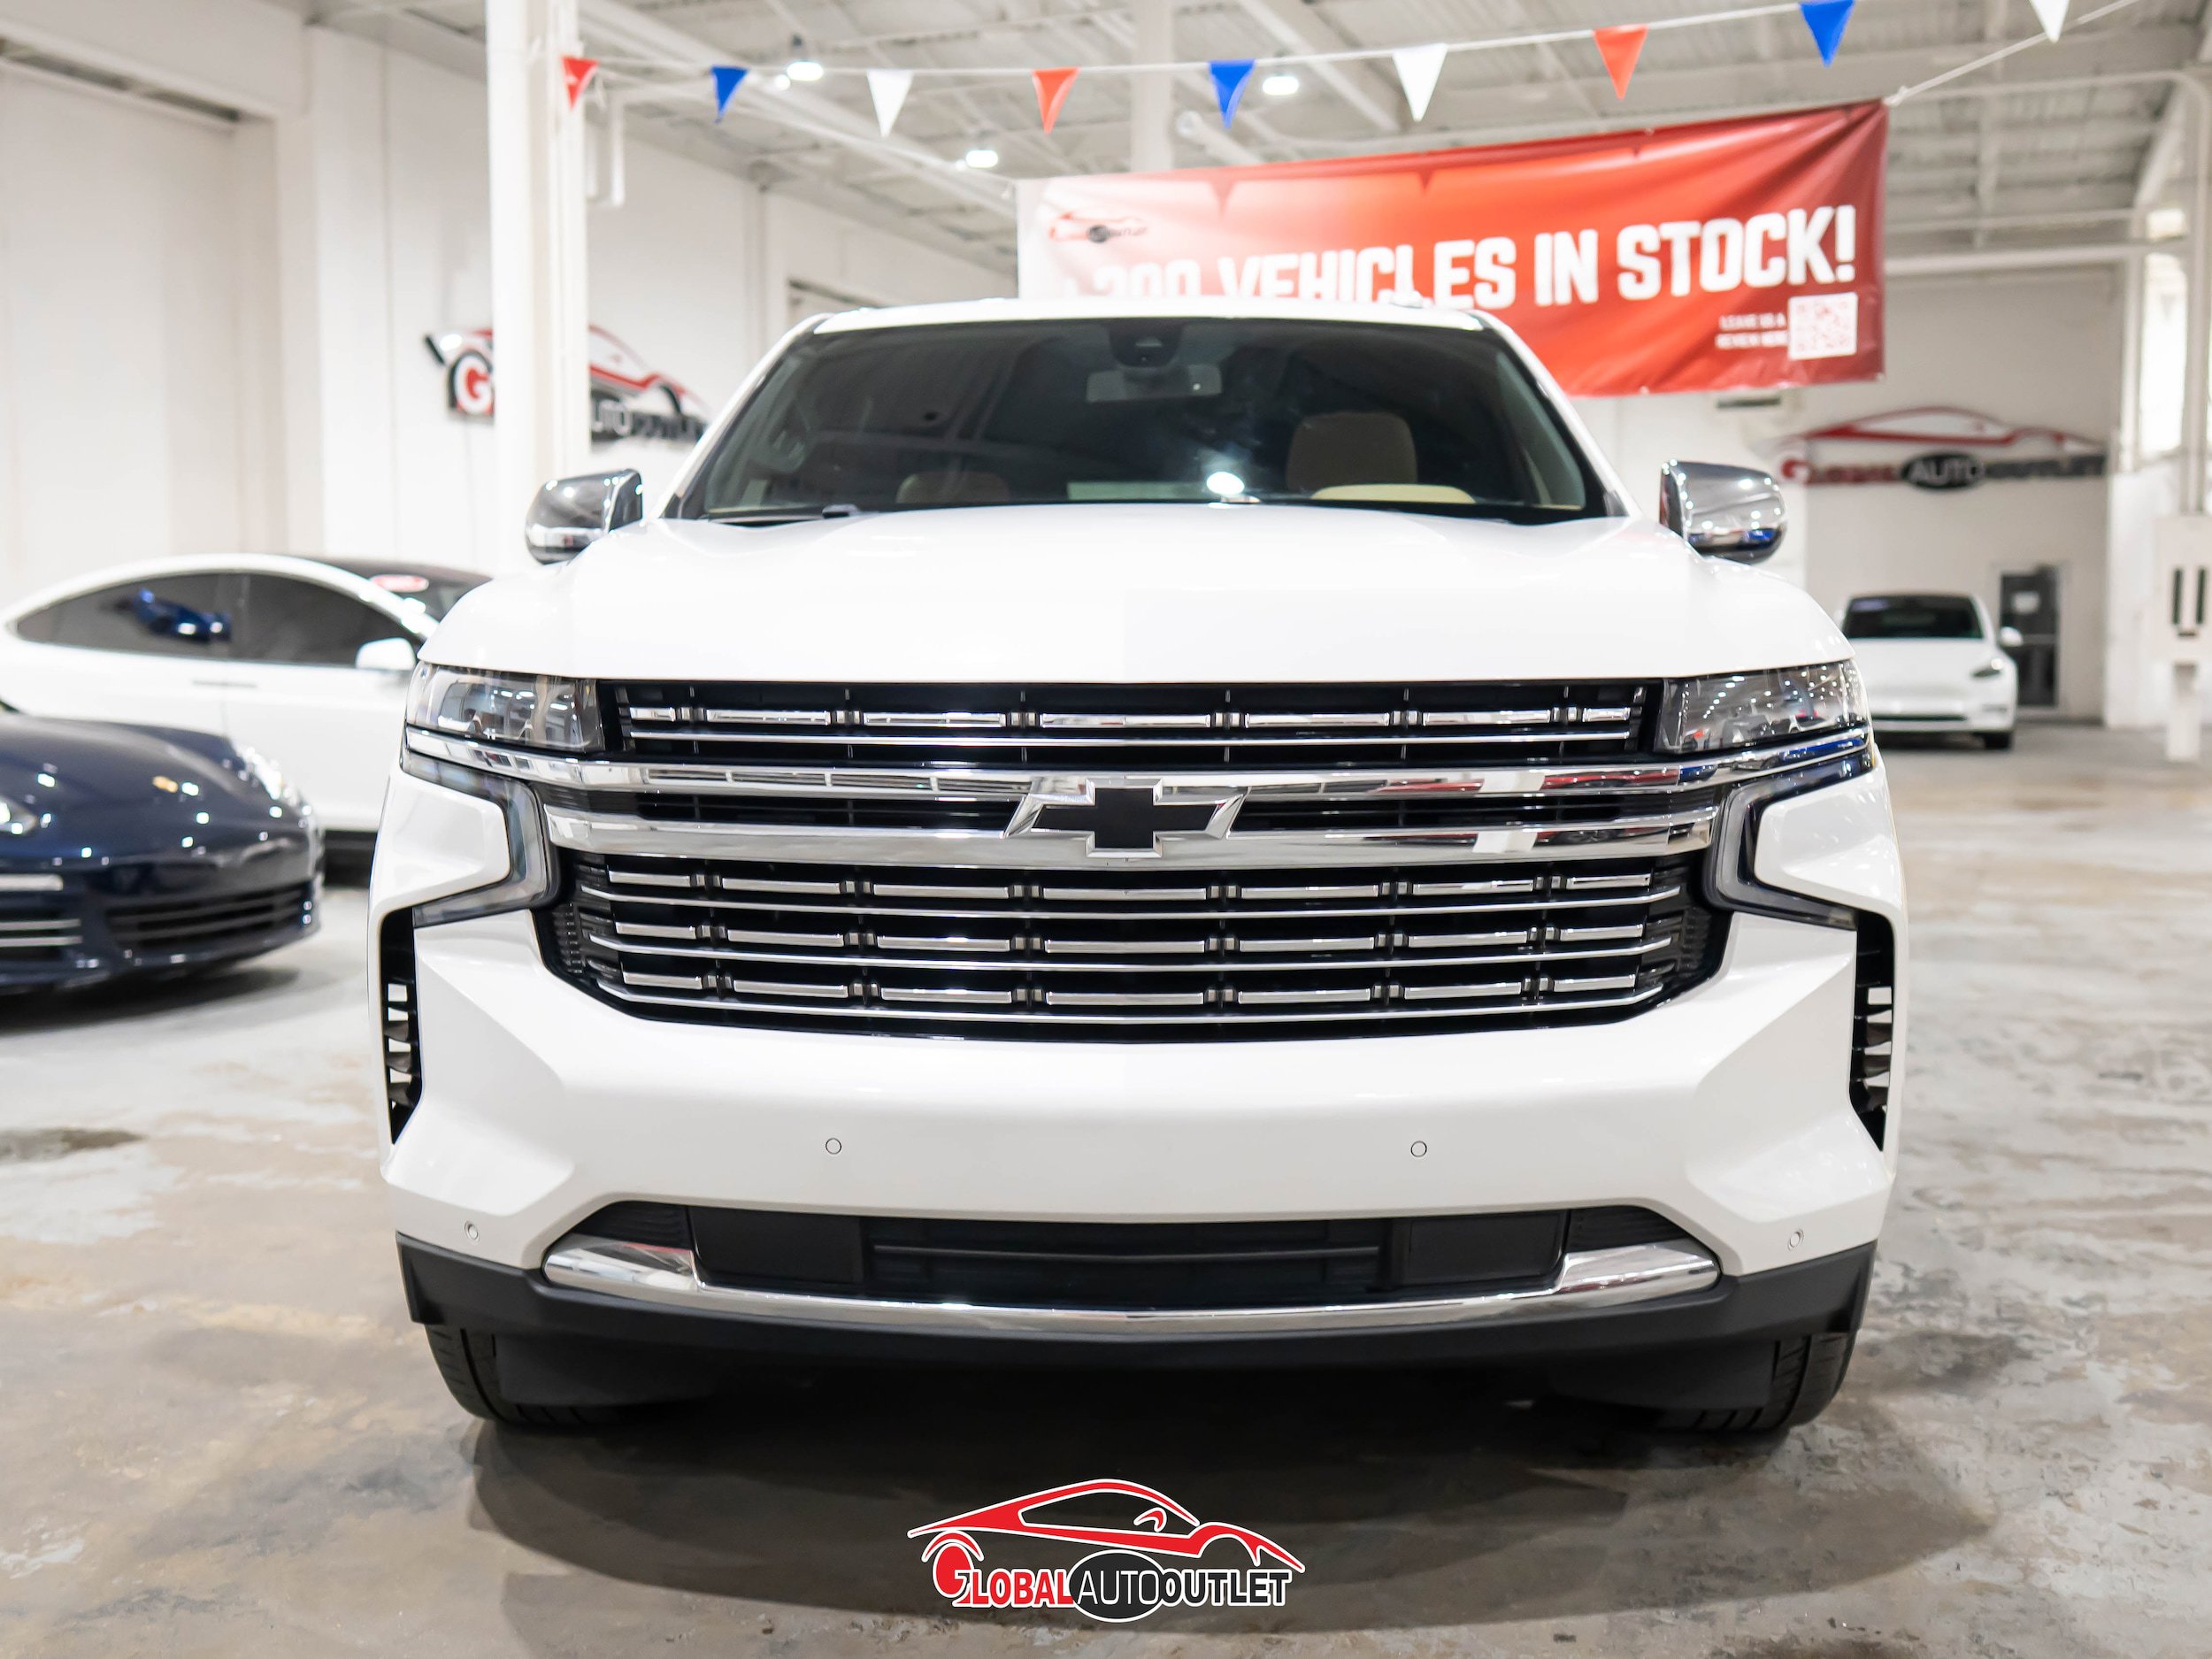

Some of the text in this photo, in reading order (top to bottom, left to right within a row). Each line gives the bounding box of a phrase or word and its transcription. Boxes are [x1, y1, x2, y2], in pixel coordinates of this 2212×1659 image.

[1217, 236, 1517, 310] VEHICLES
[1534, 229, 1599, 307] IN
[1617, 204, 1856, 301] STOCK!
